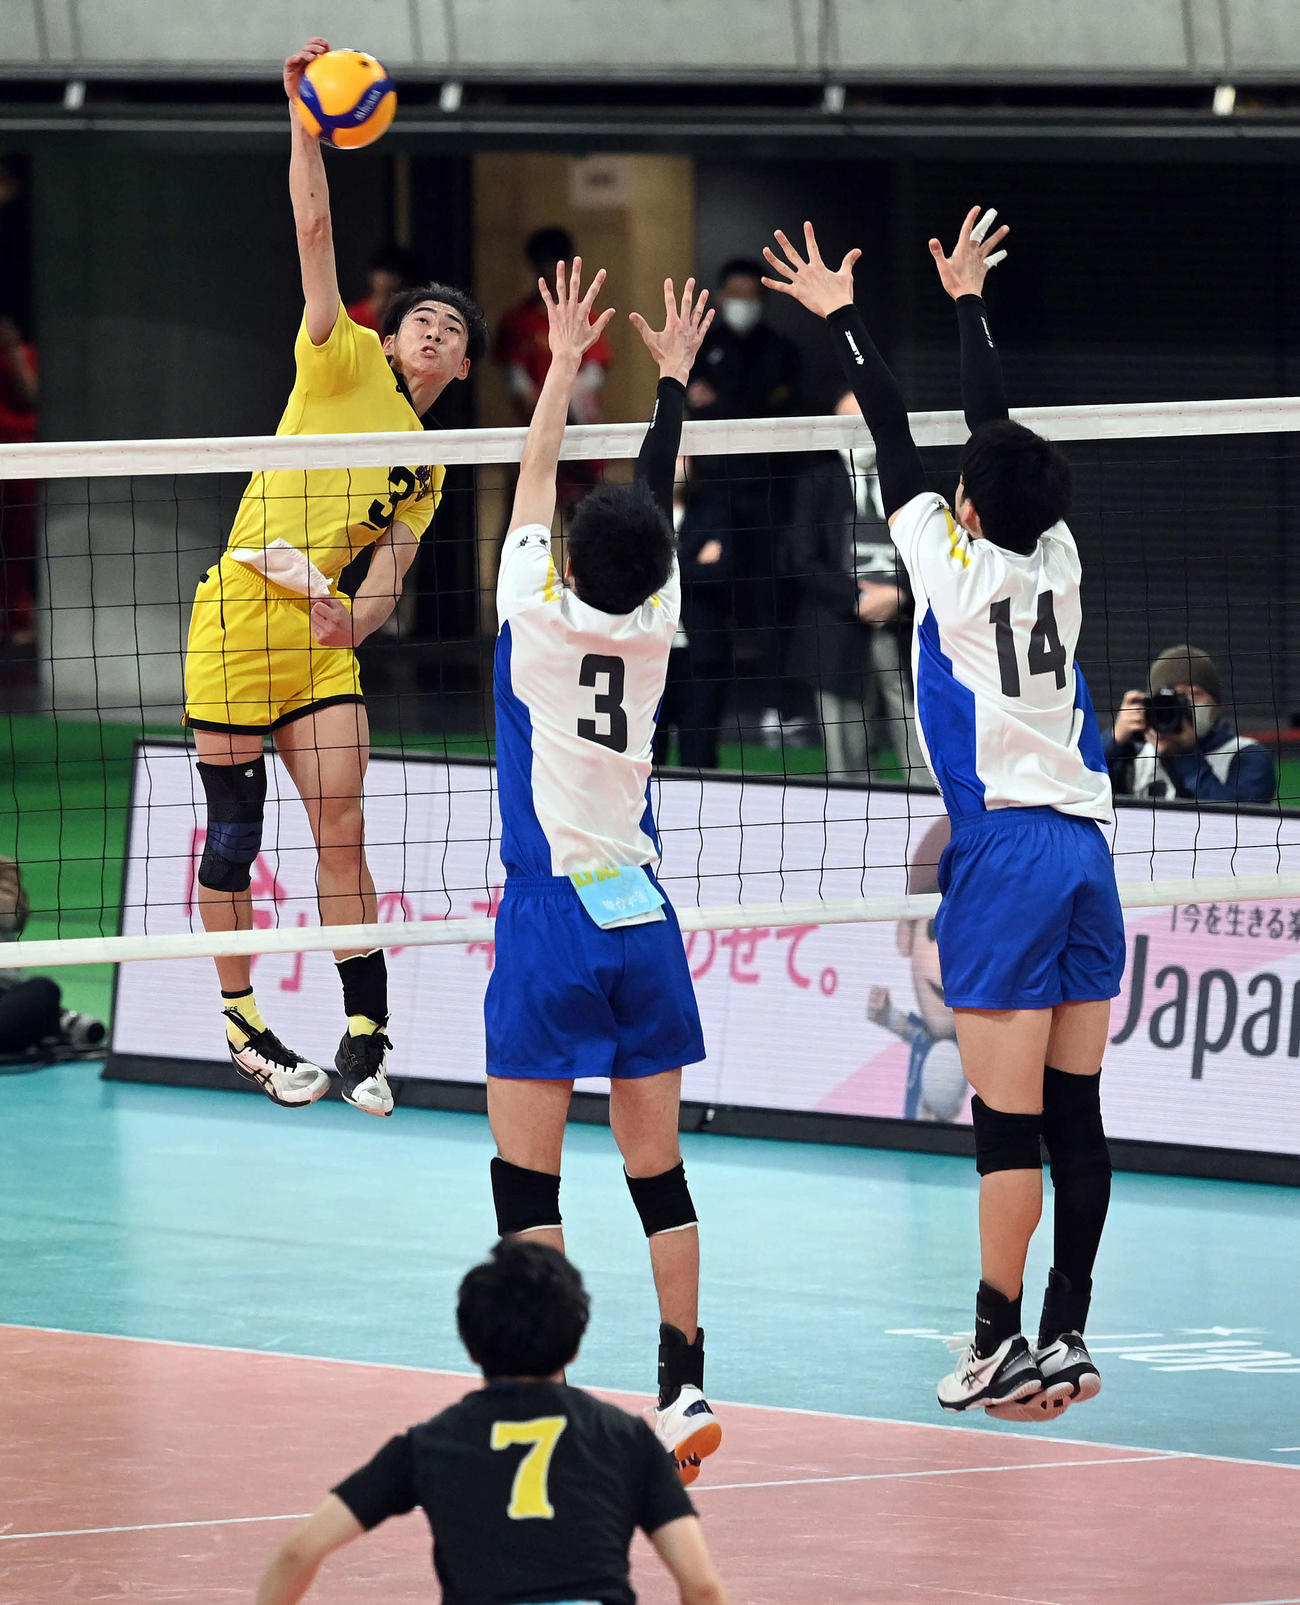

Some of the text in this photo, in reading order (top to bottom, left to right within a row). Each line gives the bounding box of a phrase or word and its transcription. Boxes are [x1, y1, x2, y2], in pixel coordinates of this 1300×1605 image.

[367, 465, 416, 529] 3
[989, 590, 1067, 698] 14
[577, 654, 628, 753] 3
[490, 1415, 568, 1520] 7
